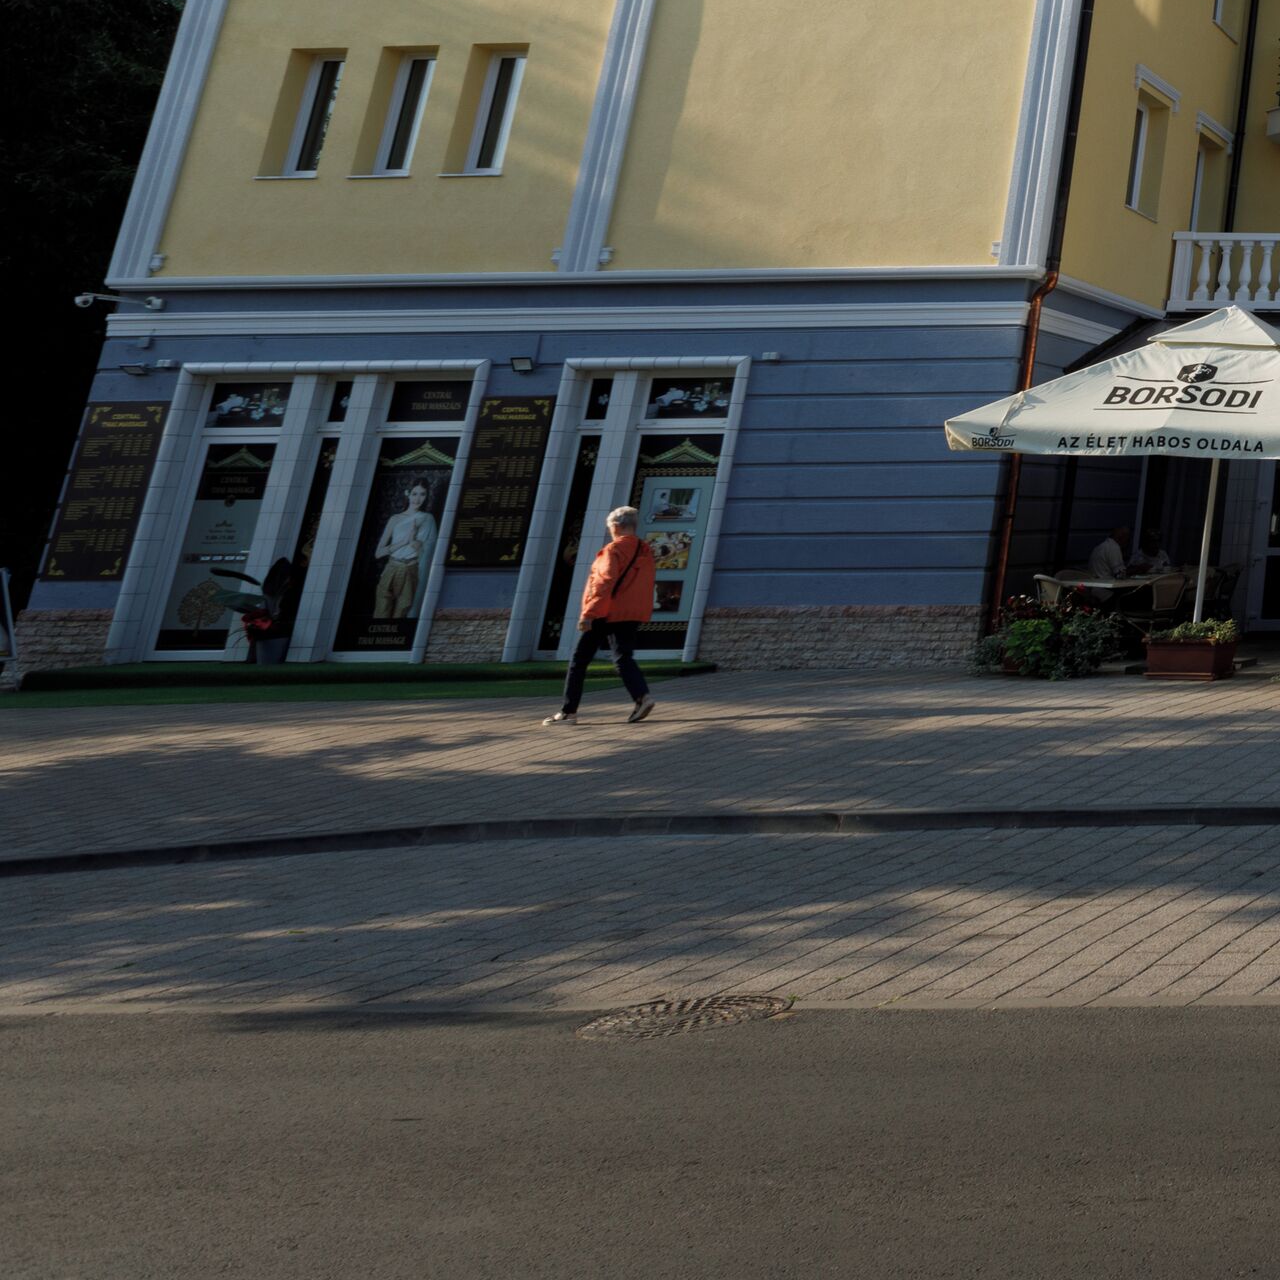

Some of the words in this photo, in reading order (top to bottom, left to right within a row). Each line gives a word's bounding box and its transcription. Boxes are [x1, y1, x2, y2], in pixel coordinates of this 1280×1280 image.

[1103, 385, 1264, 409] BORSODI
[971, 436, 1015, 448] BORSODI
[1057, 437, 1080, 449] AZ
[1086, 433, 1127, 449] ÉLET
[1132, 435, 1191, 449] HABOS
[1196, 437, 1264, 452] OLDALA
